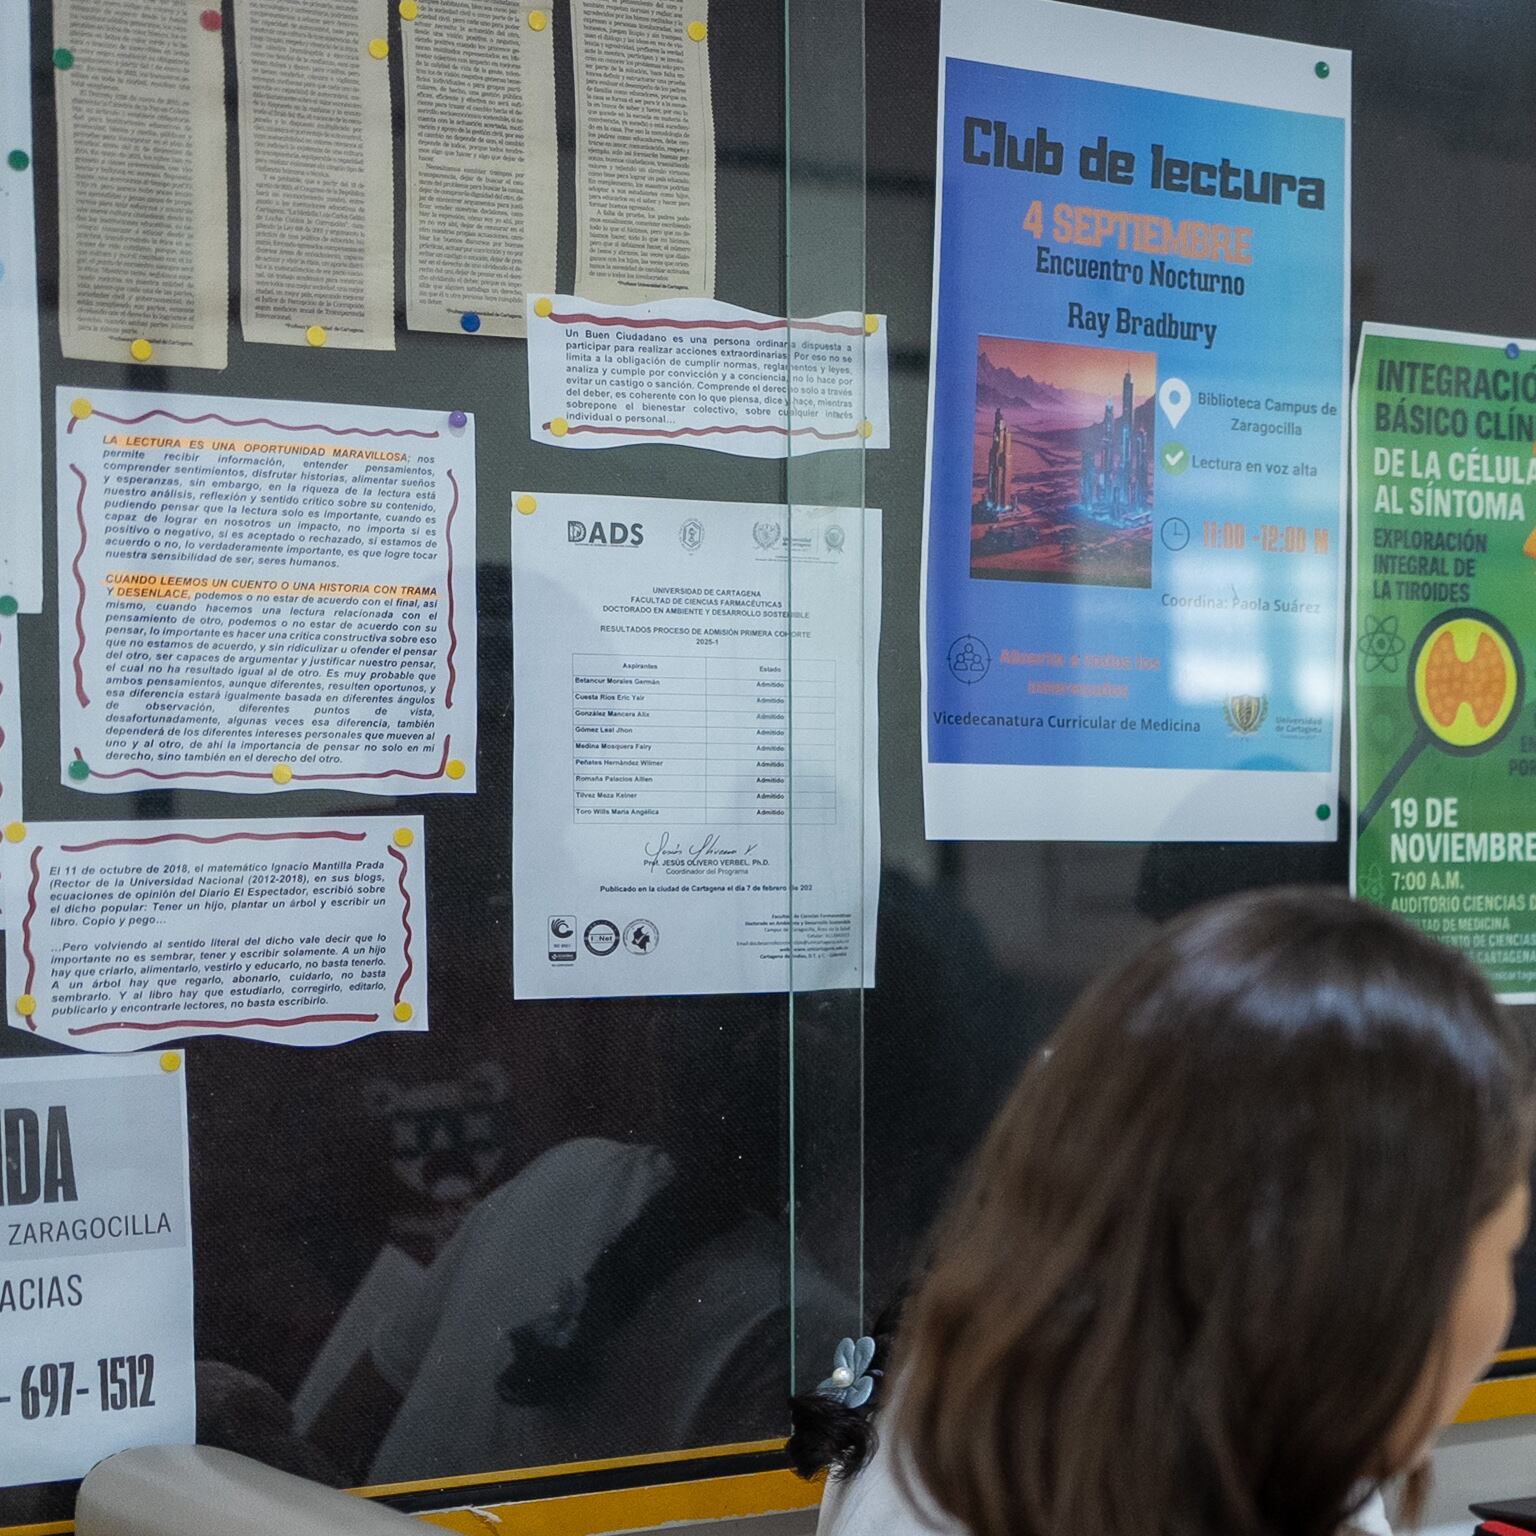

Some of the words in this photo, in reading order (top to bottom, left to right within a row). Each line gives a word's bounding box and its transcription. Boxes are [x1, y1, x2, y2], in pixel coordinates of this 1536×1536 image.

[963, 116, 1063, 175] Club
[1079, 136, 1135, 185] de
[1151, 144, 1324, 210] lectura
[1023, 200, 1043, 239] 4
[1053, 203, 1253, 264] SEPTIEMBRE
[1037, 246, 1142, 285] Encuentro
[1150, 261, 1245, 296] Nocturno
[1068, 302, 1109, 338] Ray
[1116, 308, 1216, 349] Bradbury
[566, 329, 579, 337] Un
[586, 330, 610, 339] Buen
[616, 331, 666, 343] Ciudadano
[691, 336, 707, 344] una
[714, 337, 750, 347] persona
[756, 339, 796, 349] ordinara
[802, 341, 842, 352] dispuesta
[1198, 392, 1261, 410] Biblioteca
[1265, 399, 1317, 416] Campus
[1321, 402, 1336, 416] de
[1231, 419, 1303, 439] Zaragocilla
[1375, 398, 1468, 438] BÁSICO
[103, 436, 117, 445] LA
[126, 437, 181, 448] LECTURA
[189, 440, 204, 449] ES
[212, 441, 235, 451] UNA
[244, 443, 325, 456] OPORTUNIDAD
[333, 447, 410, 463] MARAVILLOSA;
[1192, 455, 1241, 472] Lectura
[1246, 462, 1261, 473] en
[1266, 464, 1288, 475] voz
[1293, 463, 1317, 477] alta
[1374, 447, 1404, 476] DE
[1411, 450, 1441, 479] LA
[1374, 485, 1403, 515] AL
[1410, 481, 1525, 521] SÍNTOMA
[568, 520, 644, 546] DADS
[1373, 527, 1488, 552] EXPLORACIÓN
[1373, 554, 1449, 577] INTEGRAL
[1453, 557, 1475, 577] DE
[106, 574, 157, 585] CUANDO
[161, 576, 208, 587] LEEMOS
[212, 578, 228, 588] UN
[231, 579, 278, 590] CUENTO
[281, 581, 290, 590] O
[293, 582, 315, 591] UNA
[319, 583, 369, 594] HISTORIA
[374, 584, 397, 595] CON
[401, 586, 437, 596] TRAMA
[653, 586, 702, 596] UNIVERSIDAD
[704, 588, 714, 596] DE
[716, 589, 761, 597] CARTAGENA
[1373, 580, 1392, 599] LA
[1396, 581, 1470, 602] TIROIDES
[603, 605, 652, 614] DOCTORADO
[654, 607, 664, 615] EN
[665, 608, 703, 616] AMBIENTE
[712, 609, 761, 618] DESARROLLO
[630, 596, 671, 605] FACULTAD
[684, 598, 718, 606] CIENCIAS
[1161, 593, 1228, 609] Coordina:
[1232, 598, 1270, 612] Paola
[1274, 599, 1320, 613] Suárez
[600, 626, 651, 634] RESULTADOS
[653, 627, 690, 635] PROCESO
[704, 628, 739, 636] ADMISIÓN
[741, 629, 772, 637] PRIMERA
[696, 638, 718, 646] 2025-1
[933, 711, 1044, 728] Vicedecanatura
[1048, 715, 1117, 730] Curricular
[1120, 717, 1136, 731] de
[1140, 717, 1200, 733] Medicina
[1391, 798, 1418, 829] 19
[1425, 798, 1458, 828] DE
[50, 867, 61, 876] El
[65, 866, 77, 875] 11
[81, 865, 96, 875] de
[99, 865, 142, 875] octubre
[146, 864, 159, 874] de
[163, 864, 191, 875] 2018,
[195, 865, 204, 873] el
[207, 862, 268, 873] matemático
[271, 862, 309, 874] Ignacio
[313, 861, 352, 871] Mantilla
[356, 861, 384, 870] Prada
[600, 885, 636, 893] Publicado
[649, 885, 654, 893] la
[657, 885, 679, 893] ciudad
[682, 885, 689, 893] de
[691, 885, 725, 894] Cartagena
[1391, 871, 1426, 891] 7:00
[1430, 871, 1464, 890] A.M.
[1391, 896, 1460, 914] AUDITORIO
[1463, 894, 1526, 912] CIENCIAS
[1442, 918, 1455, 932] DE
[1458, 917, 1510, 931] MEDICINA
[1472, 934, 1486, 947] DE
[1478, 950, 1536, 964] CARTAGENA
[8, 1212, 171, 1245] ZARAGOCILLA
[97, 1354, 155, 1412] 1512
